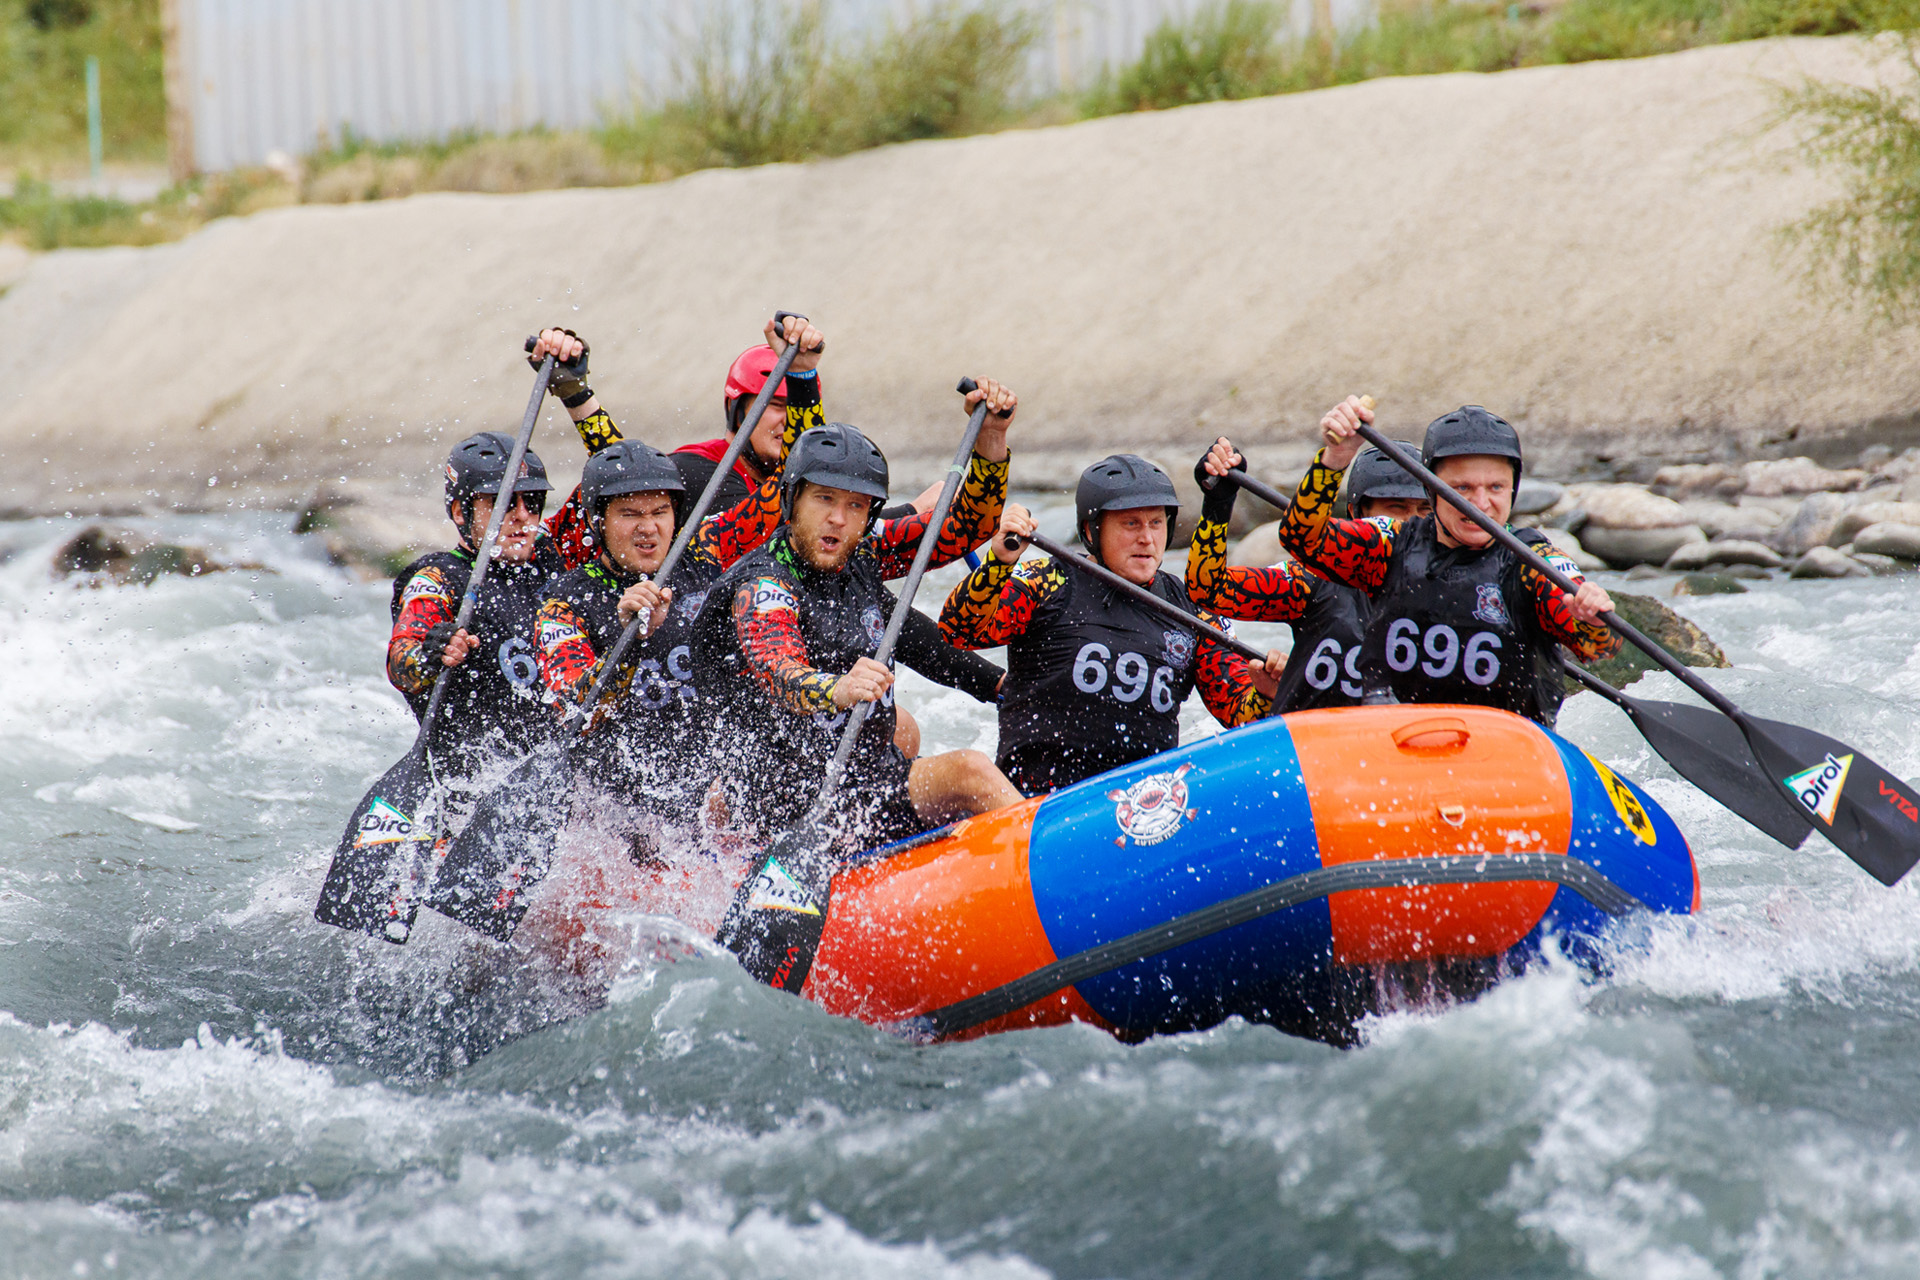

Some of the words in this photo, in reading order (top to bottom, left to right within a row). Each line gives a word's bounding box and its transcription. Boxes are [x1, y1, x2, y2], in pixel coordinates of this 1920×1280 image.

[541, 624, 578, 647] Dirol
[1385, 617, 1504, 686] 696
[1072, 642, 1174, 713] 696
[1304, 637, 1363, 698] 69
[1799, 756, 1843, 812] Dirol
[1878, 779, 1919, 824] VITA
[360, 814, 413, 835] Diro
[769, 946, 800, 989] VITA
